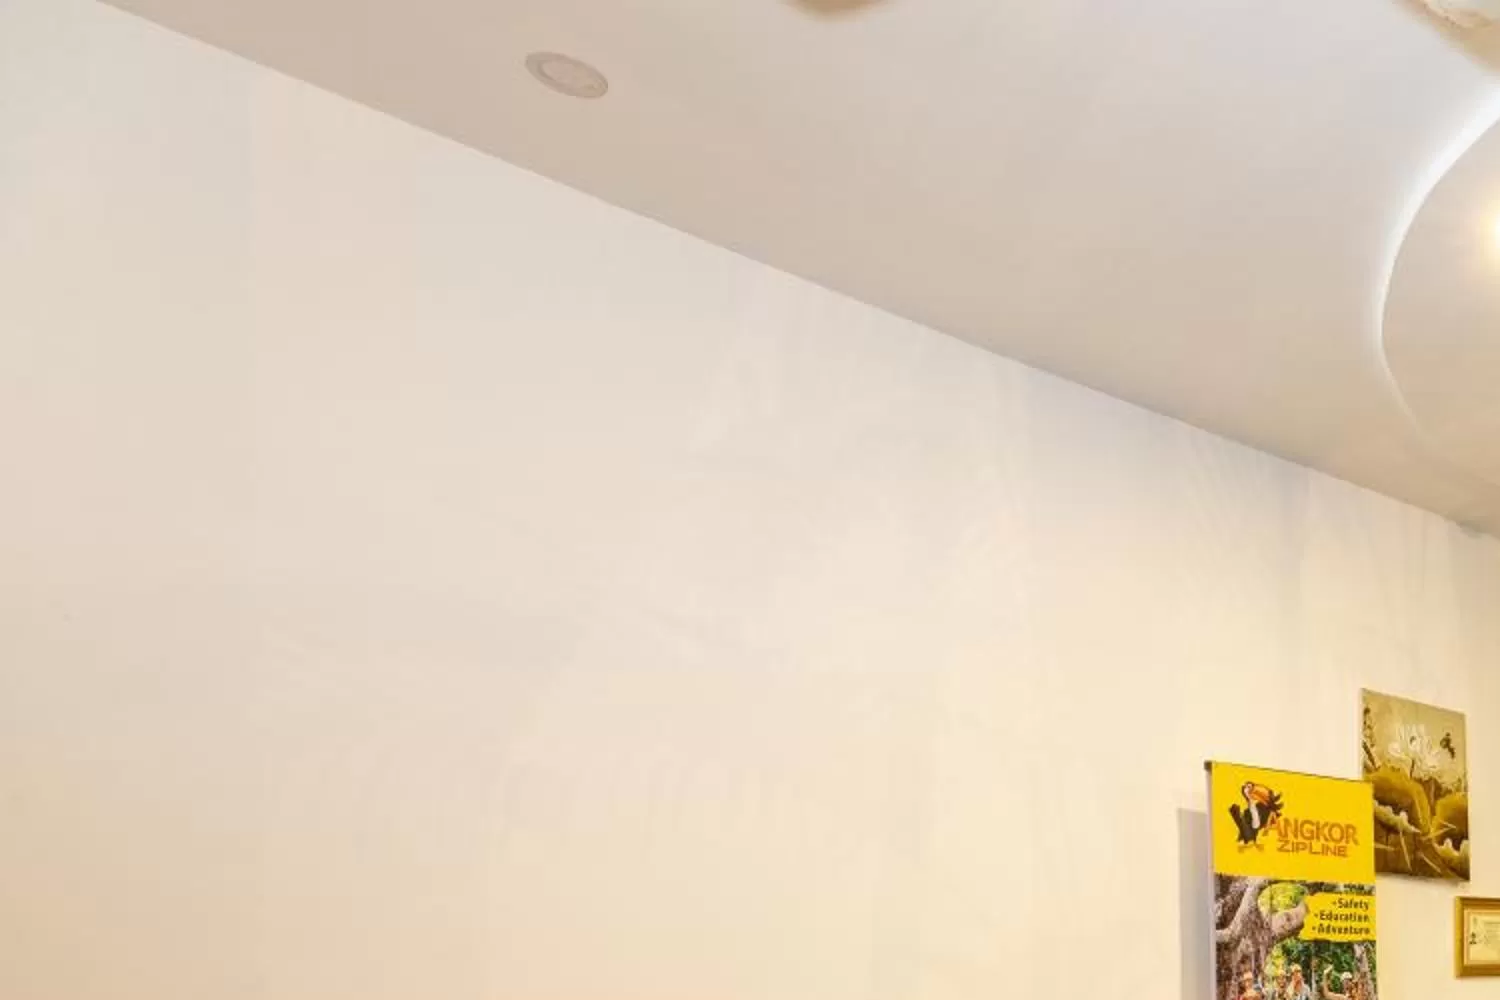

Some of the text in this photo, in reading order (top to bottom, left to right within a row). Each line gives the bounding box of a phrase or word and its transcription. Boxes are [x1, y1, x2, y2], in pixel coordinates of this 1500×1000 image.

[1263, 811, 1360, 846] ANGKOR
[1277, 839, 1348, 857] ZIPLINE
[1337, 898, 1370, 912] Safety
[1319, 911, 1371, 924] Education
[1317, 924, 1371, 936] Adventure
